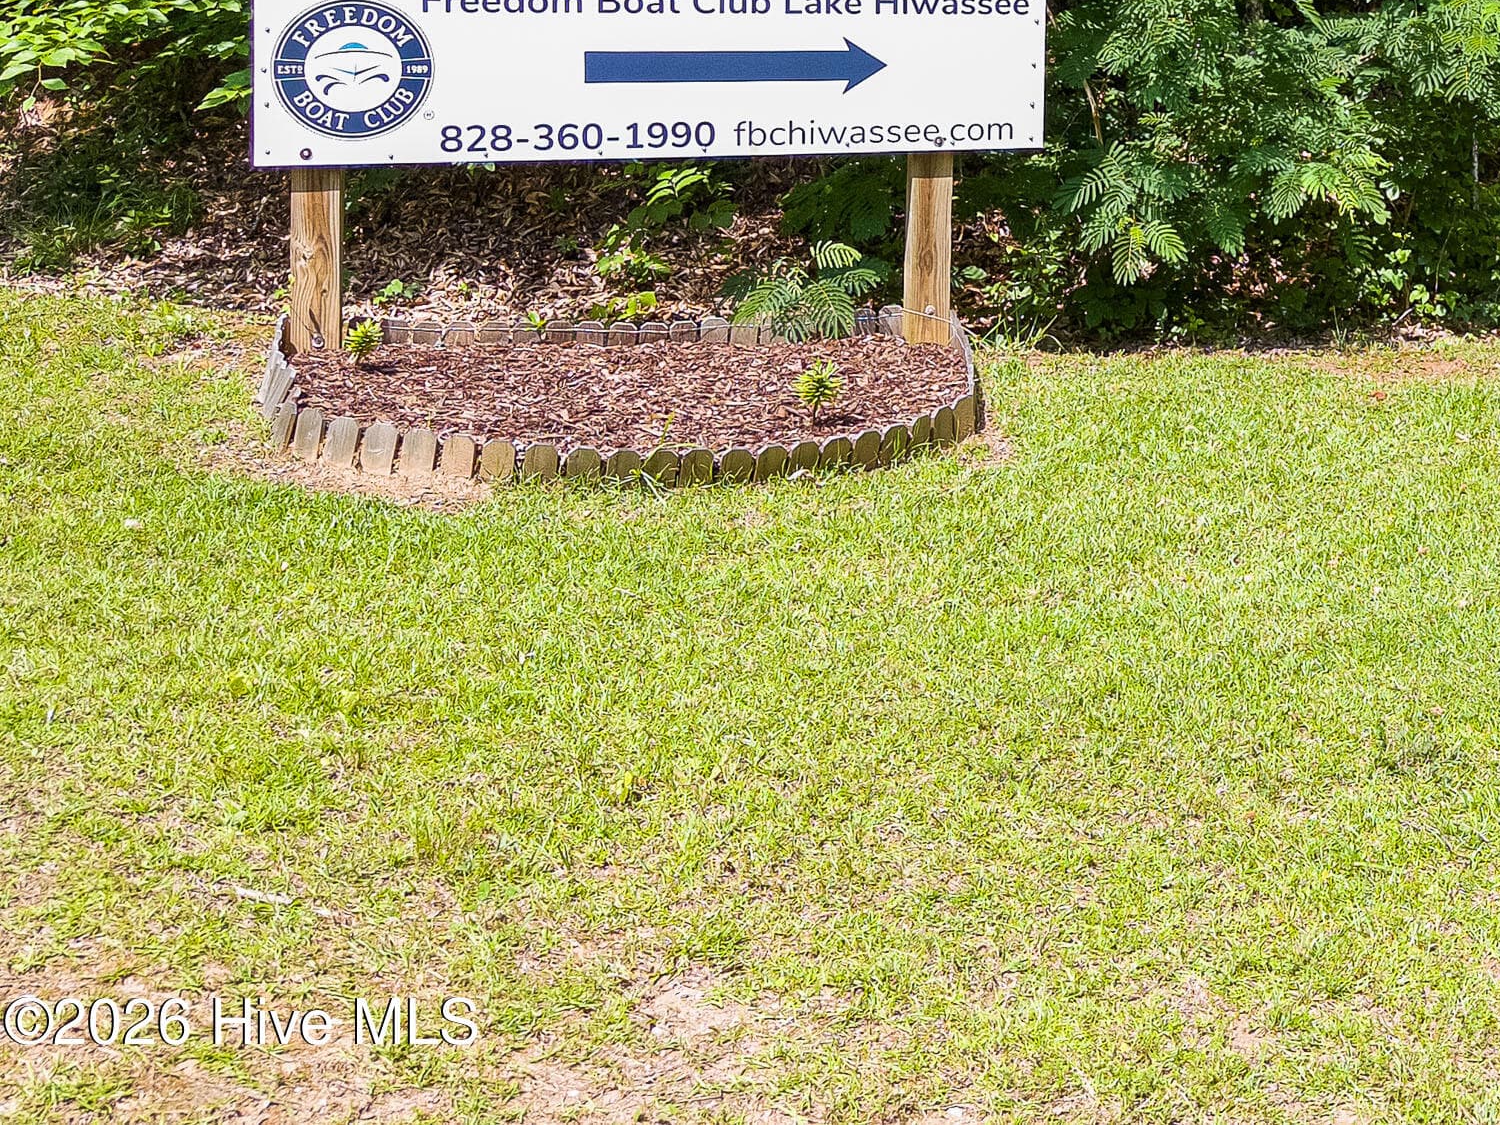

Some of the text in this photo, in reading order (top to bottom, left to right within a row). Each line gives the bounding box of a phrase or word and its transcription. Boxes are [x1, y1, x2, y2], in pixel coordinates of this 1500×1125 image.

[292, 7, 414, 47] FREEDOM
[406, 65, 428, 73] 1989
[293, 88, 414, 130] BOAT CLUB
[439, 118, 1014, 153] 828-360-1990 fbchiwassee.com
